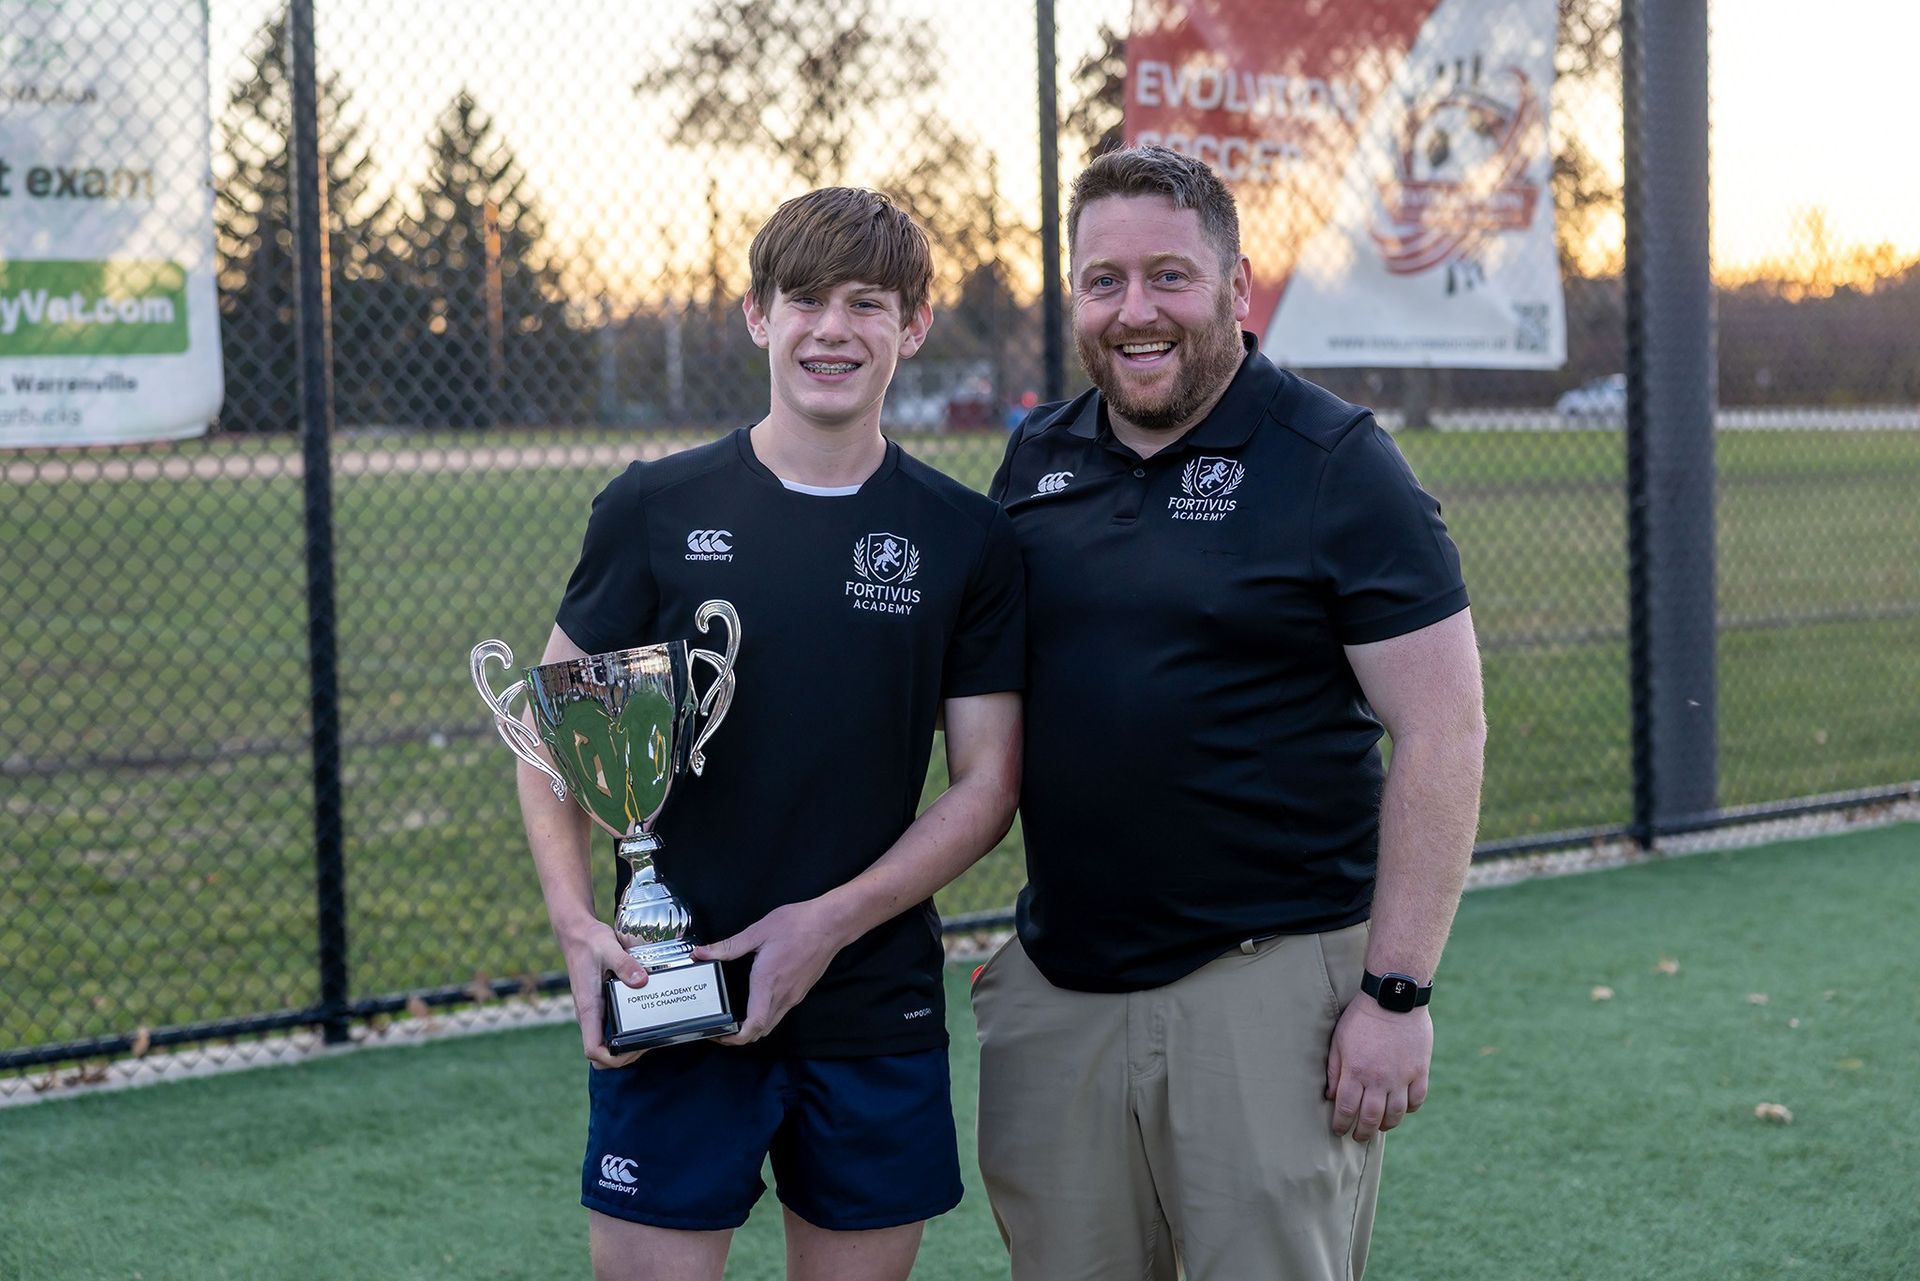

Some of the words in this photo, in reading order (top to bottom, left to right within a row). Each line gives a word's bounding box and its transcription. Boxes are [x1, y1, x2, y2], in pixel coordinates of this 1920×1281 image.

[1136, 60, 1361, 124] EVOLUTION
[26, 165, 155, 198] exam
[0, 288, 175, 335] yVet.com
[11, 372, 138, 394] Warrenville
[1167, 496, 1237, 511] FORTIVUS
[1171, 510, 1227, 521] ACADEMY
[684, 552, 734, 562] canterbury
[845, 581, 921, 603] FORTIVUS
[853, 599, 913, 615] ACADEMY
[627, 992, 659, 1004] FORTIVUS
[660, 985, 692, 998] ACADEMY
[693, 983, 708, 992] CUP
[641, 1001, 655, 1010] U15
[656, 993, 697, 1007] CHAMPIONS
[598, 1179, 638, 1196] canterbury
